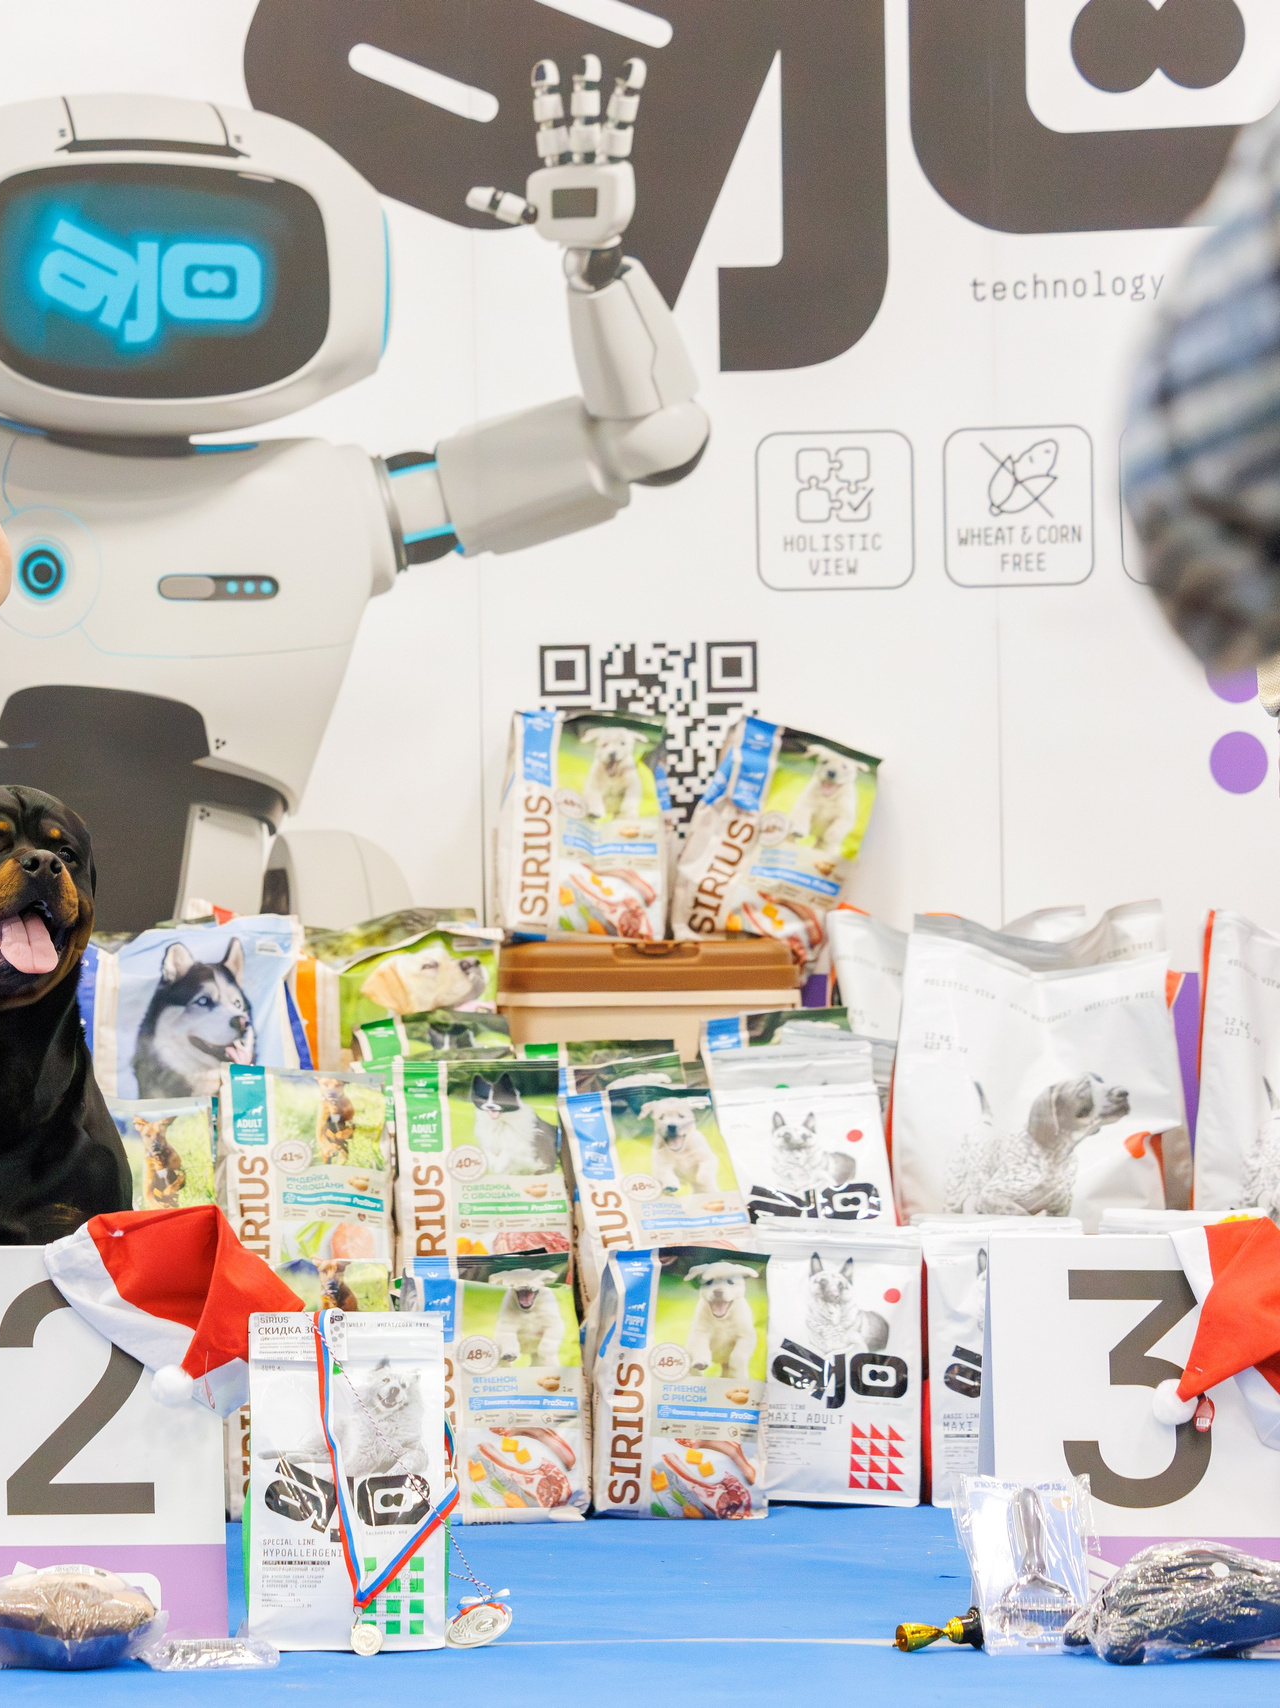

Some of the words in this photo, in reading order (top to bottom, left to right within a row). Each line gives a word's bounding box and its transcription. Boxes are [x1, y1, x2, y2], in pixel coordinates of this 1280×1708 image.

[970, 270, 1166, 303] technology
[783, 533, 883, 552] HOLISTIC
[957, 526, 1016, 547] WHEAT
[1036, 524, 1083, 545] CORN
[809, 557, 858, 576] VIEW
[1000, 552, 1047, 572] FREE
[520, 795, 552, 917] SIRIUS
[687, 818, 755, 934] SIRIUS
[924, 978, 969, 992] HOLISTIC
[236, 1118, 263, 1129] ADULT
[411, 1123, 438, 1134] ADULT
[412, 1165, 448, 1257] RIUS
[258, 1326, 302, 1336] СКИДКА
[466, 1349, 493, 1361] 48%
[658, 1357, 684, 1368] 48%
[662, 1384, 707, 1393] ЯГНЕНОК
[1063, 1269, 1213, 1509] 3
[671, 1393, 707, 1403] РИСОМ
[806, 1412, 845, 1425] ADULT
[943, 1421, 973, 1432] MAXI
[608, 1363, 645, 1505] SIRIUS
[263, 1548, 343, 1558] HYPOALLERGENI
